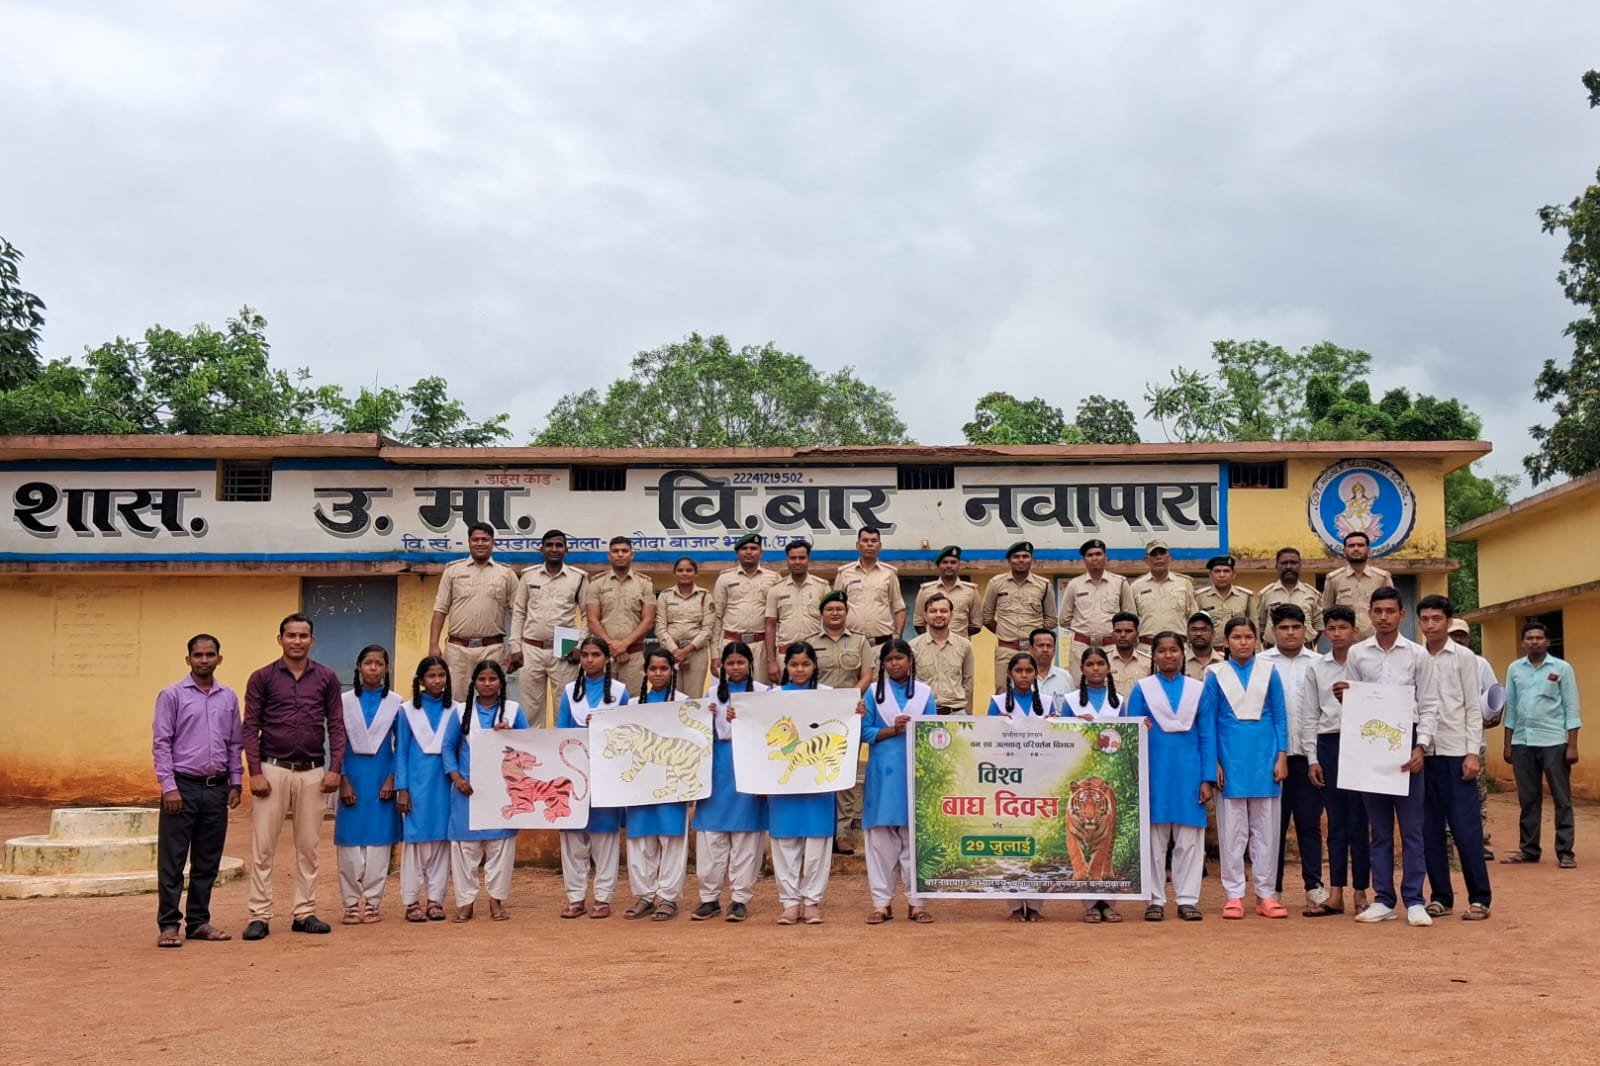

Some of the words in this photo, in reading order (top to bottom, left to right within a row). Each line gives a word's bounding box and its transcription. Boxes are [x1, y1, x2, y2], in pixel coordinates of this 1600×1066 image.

[733, 472, 803, 484] 22241219502
[961, 483, 1219, 533] नवापारा
[978, 762, 1024, 785] विश्व
[942, 796, 986, 816] बाघ
[995, 790, 1059, 818] दिवस
[966, 841, 984, 851] 29
[989, 837, 1031, 856] जुलाई
